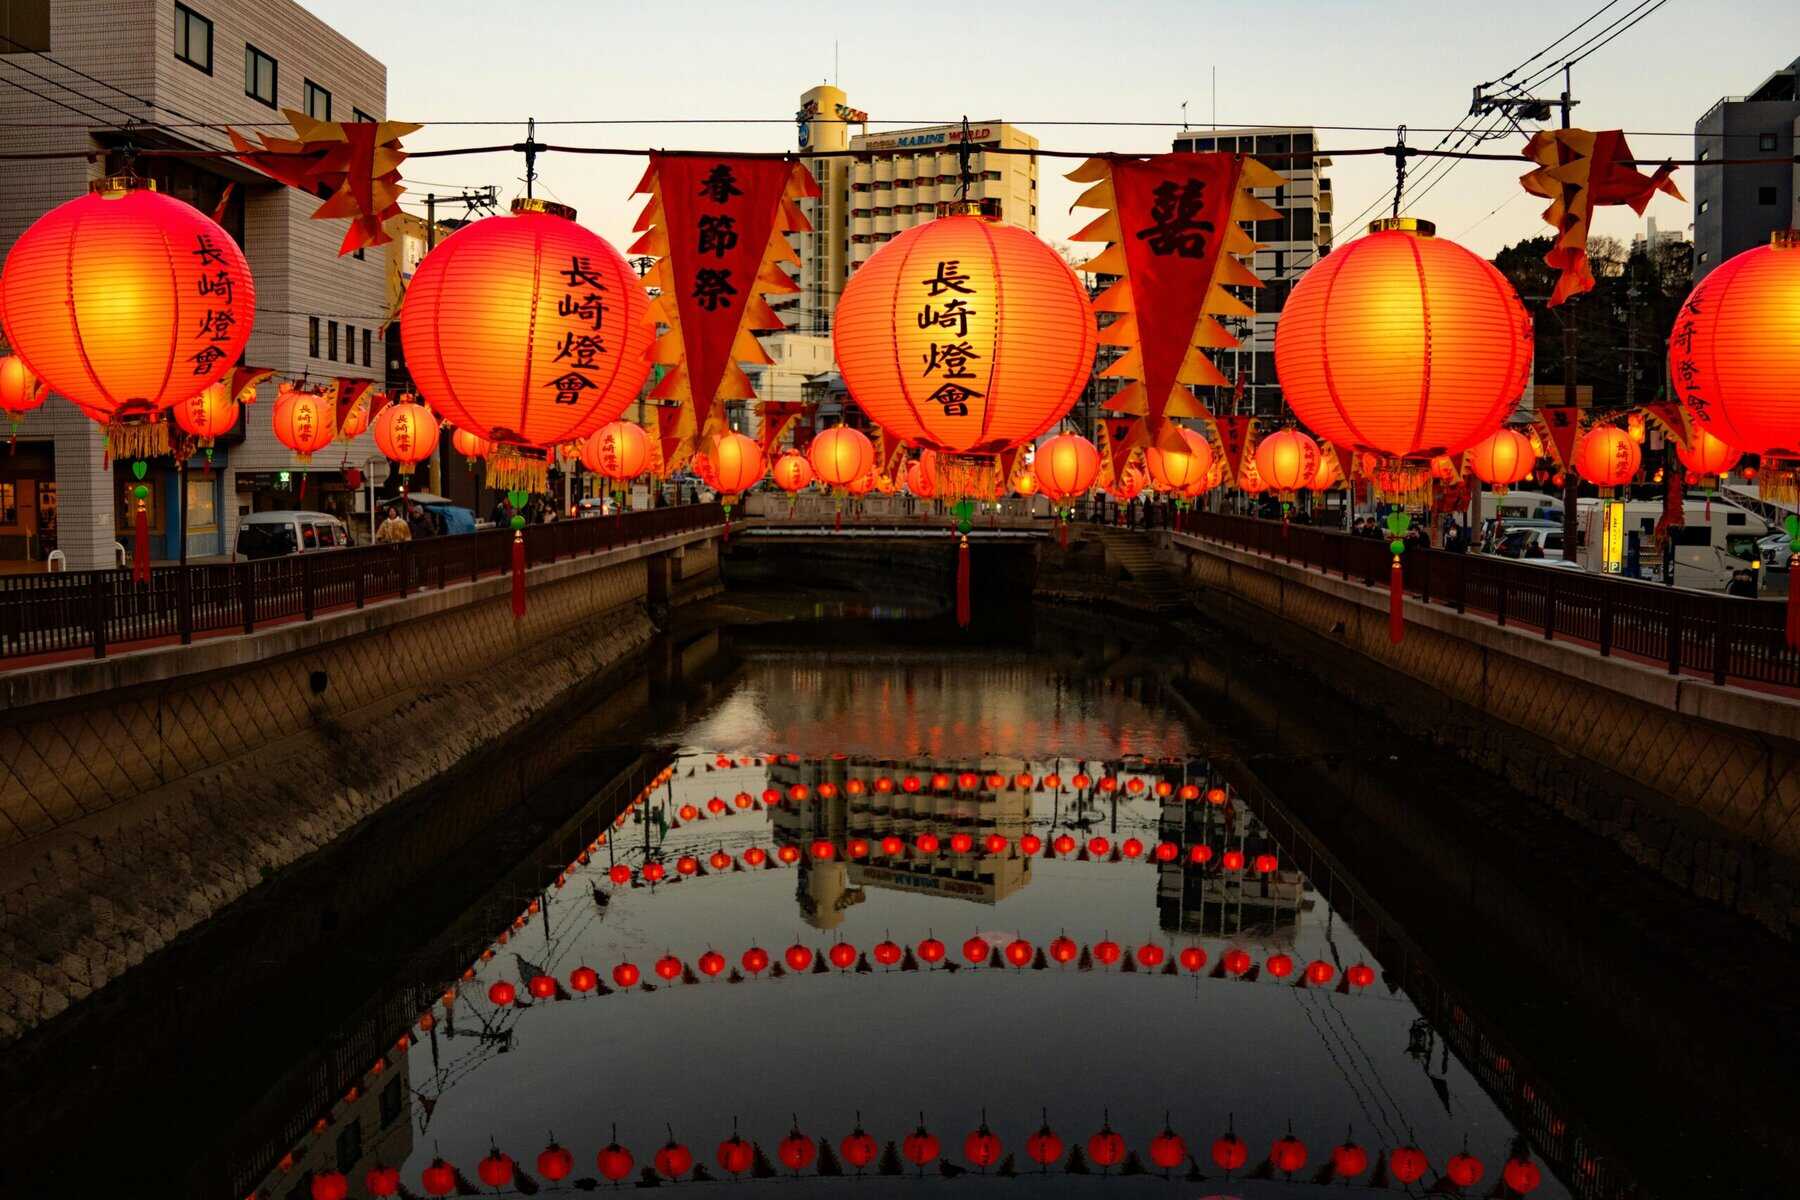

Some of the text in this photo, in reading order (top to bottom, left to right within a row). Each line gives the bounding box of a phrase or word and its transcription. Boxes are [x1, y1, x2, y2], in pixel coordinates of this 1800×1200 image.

[898, 133, 946, 147] MARINE
[948, 127, 991, 142] WRLD
[186, 234, 236, 376] 長崎燈會
[692, 164, 744, 311] 春節祭
[543, 256, 609, 405] 長崎燈會
[918, 260, 986, 416] 長崎燈會
